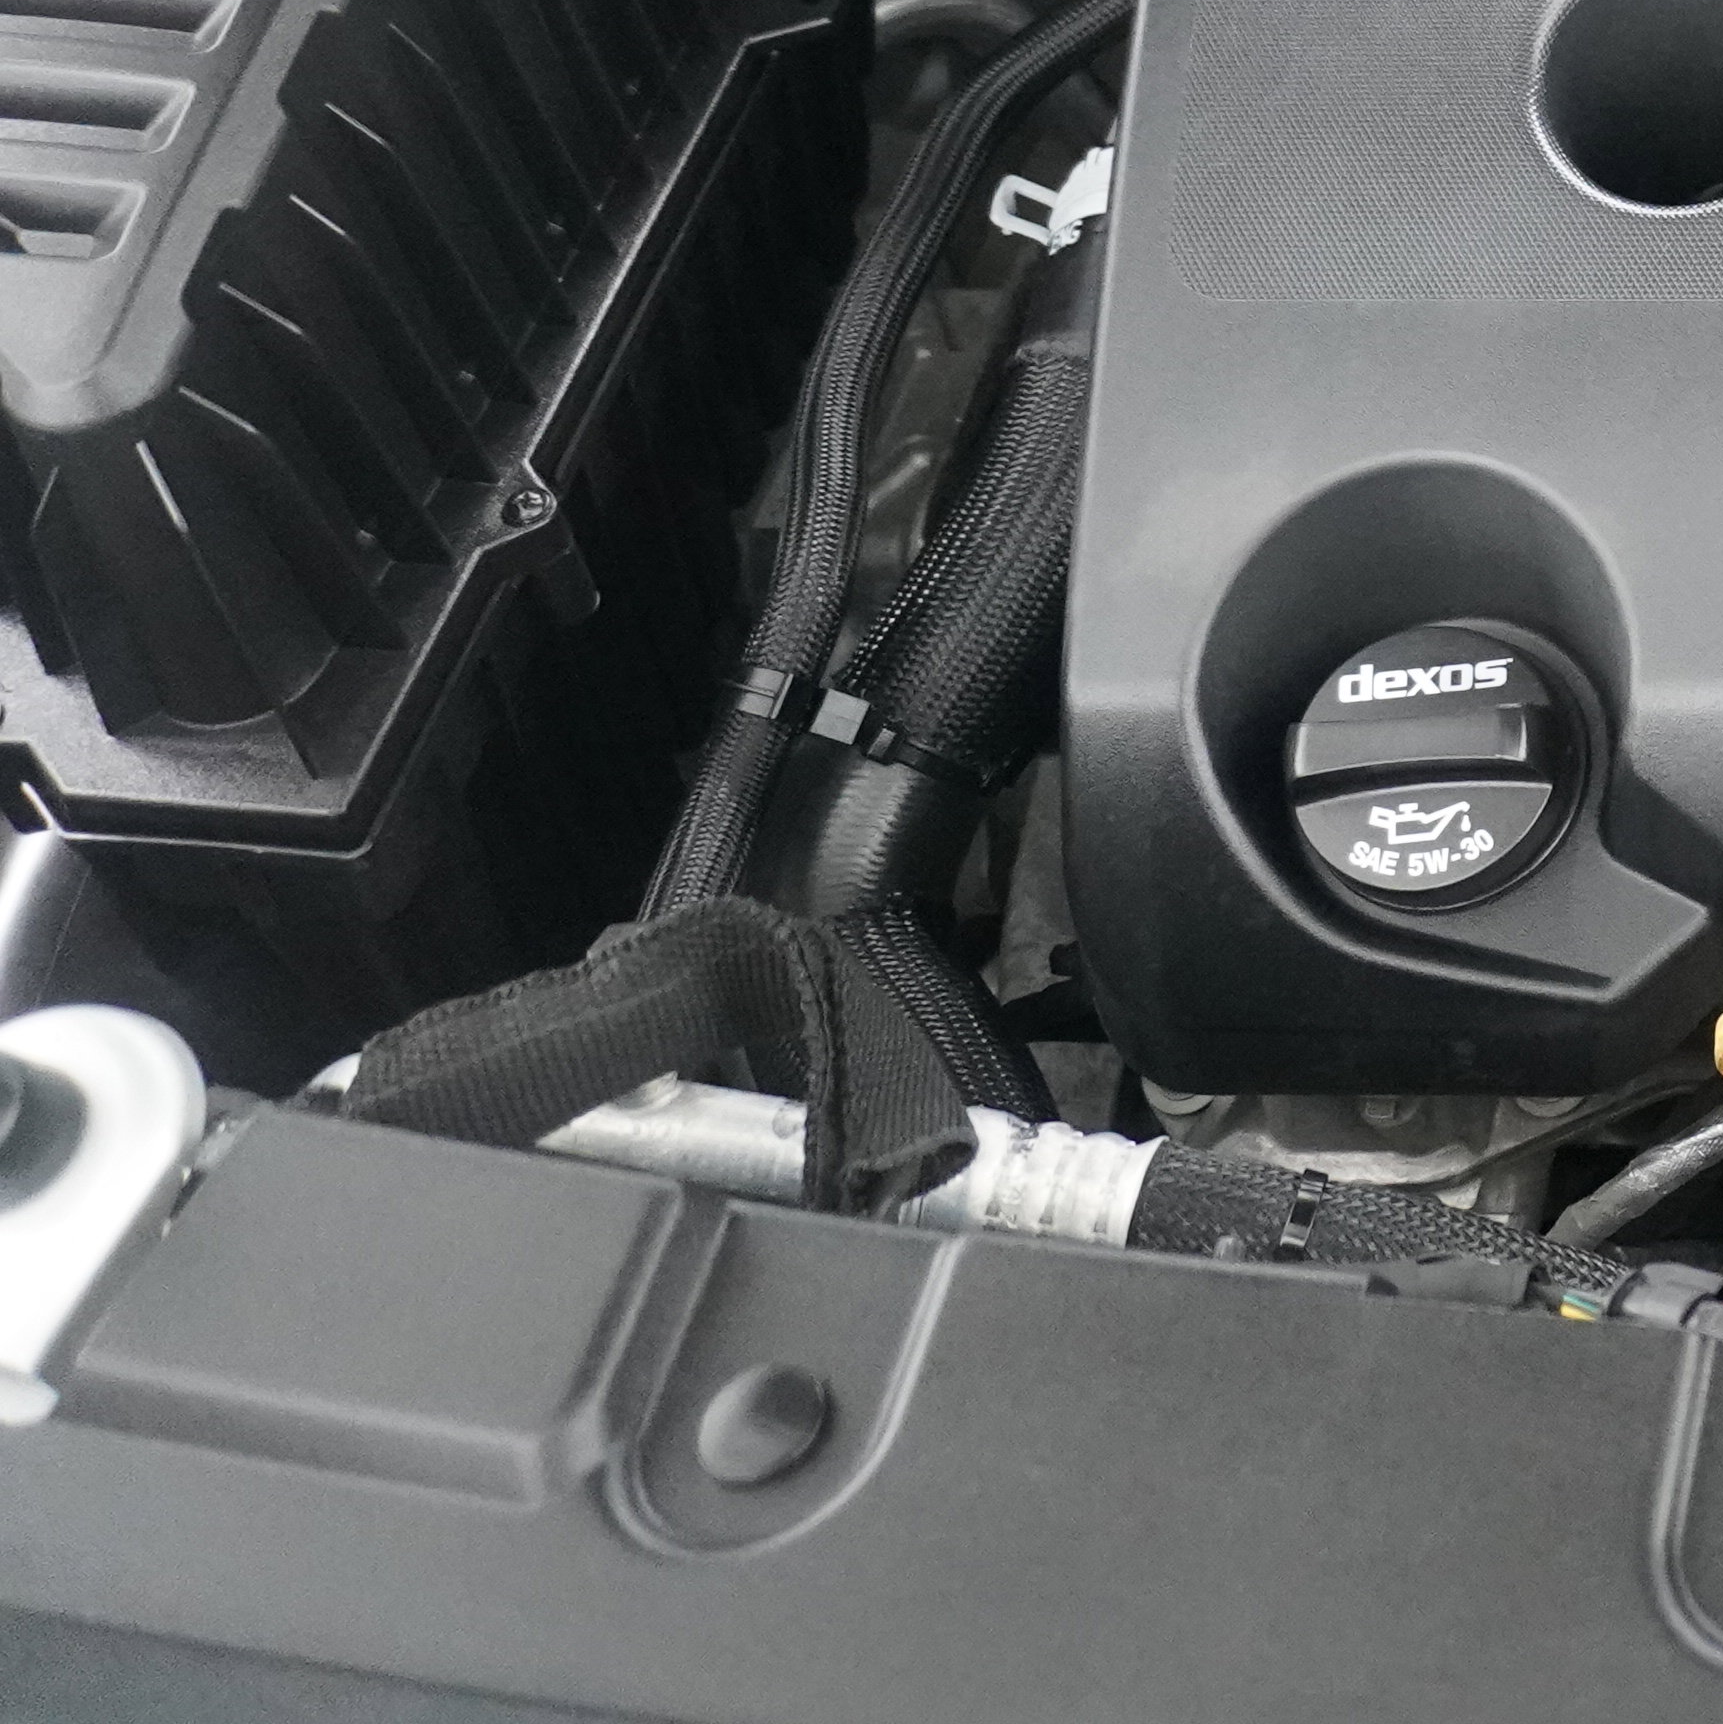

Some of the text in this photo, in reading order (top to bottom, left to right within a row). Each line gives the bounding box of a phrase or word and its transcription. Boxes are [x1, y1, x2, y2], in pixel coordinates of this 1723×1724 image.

[1337, 658, 1510, 703] dexos
[1349, 828, 1495, 877] SAE 5W-30
